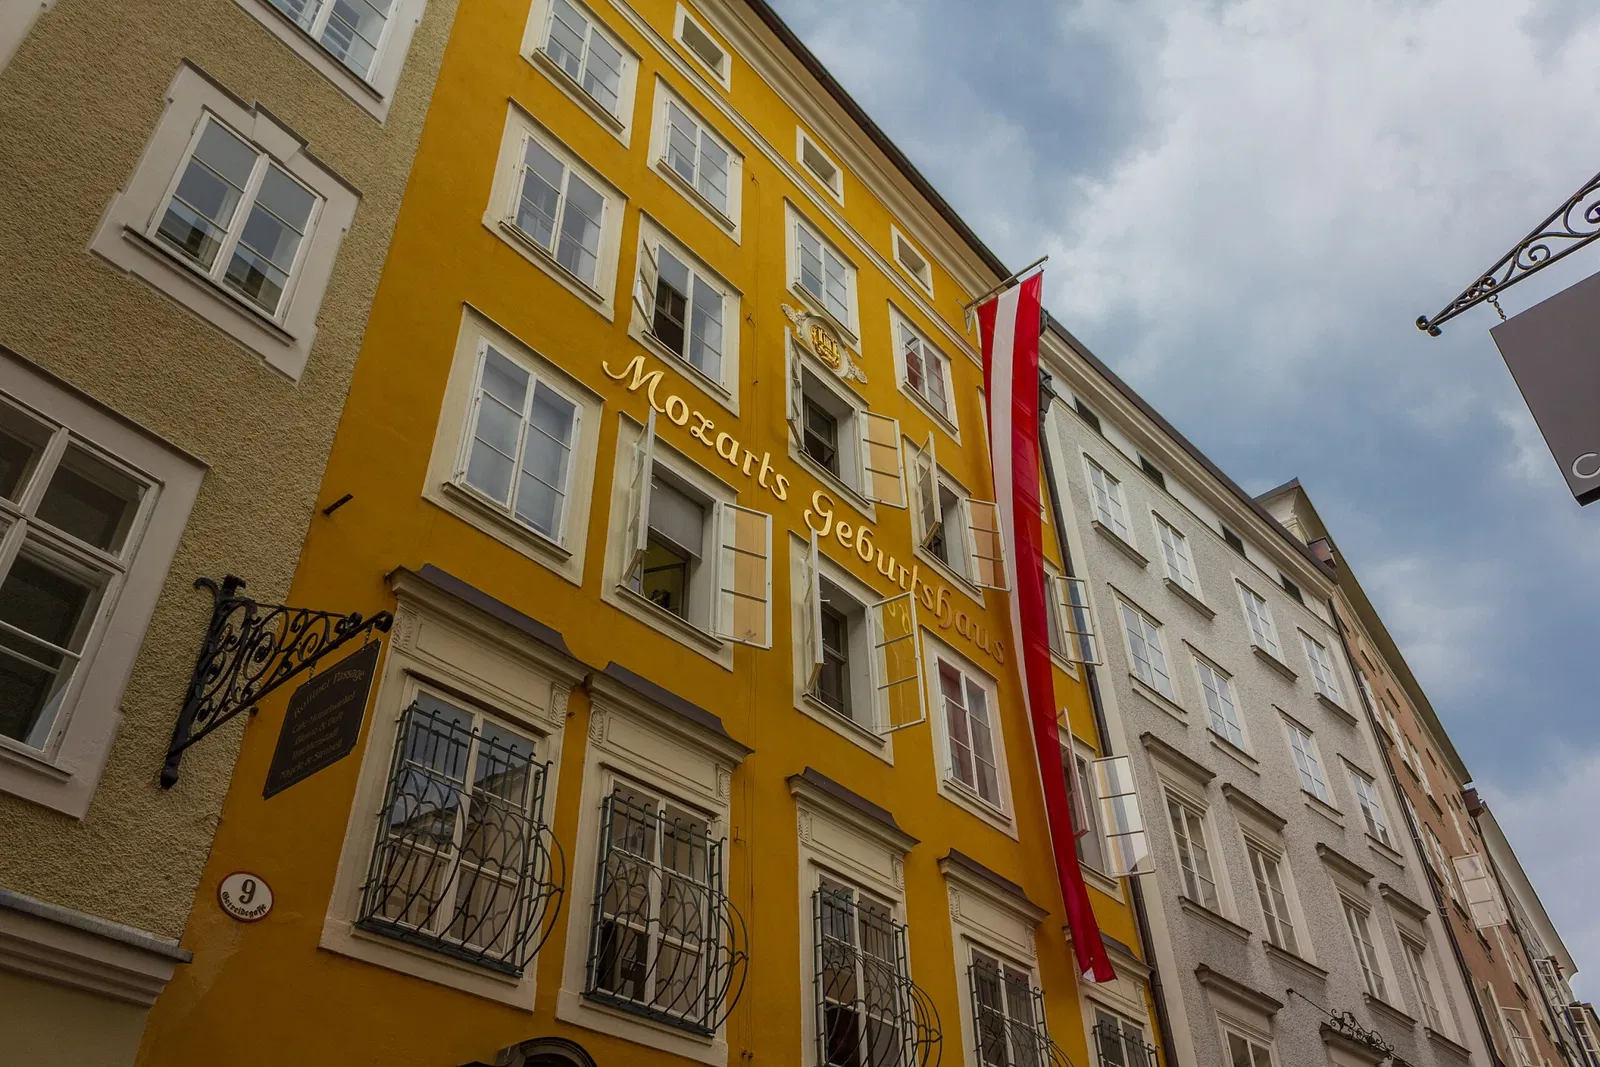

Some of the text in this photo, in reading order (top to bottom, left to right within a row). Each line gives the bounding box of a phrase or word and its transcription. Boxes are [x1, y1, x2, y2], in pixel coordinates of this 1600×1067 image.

[602, 355, 1006, 664] Mozarts Geburtshaus
[332, 669, 365, 684] Passage
[238, 879, 257, 905] 9
